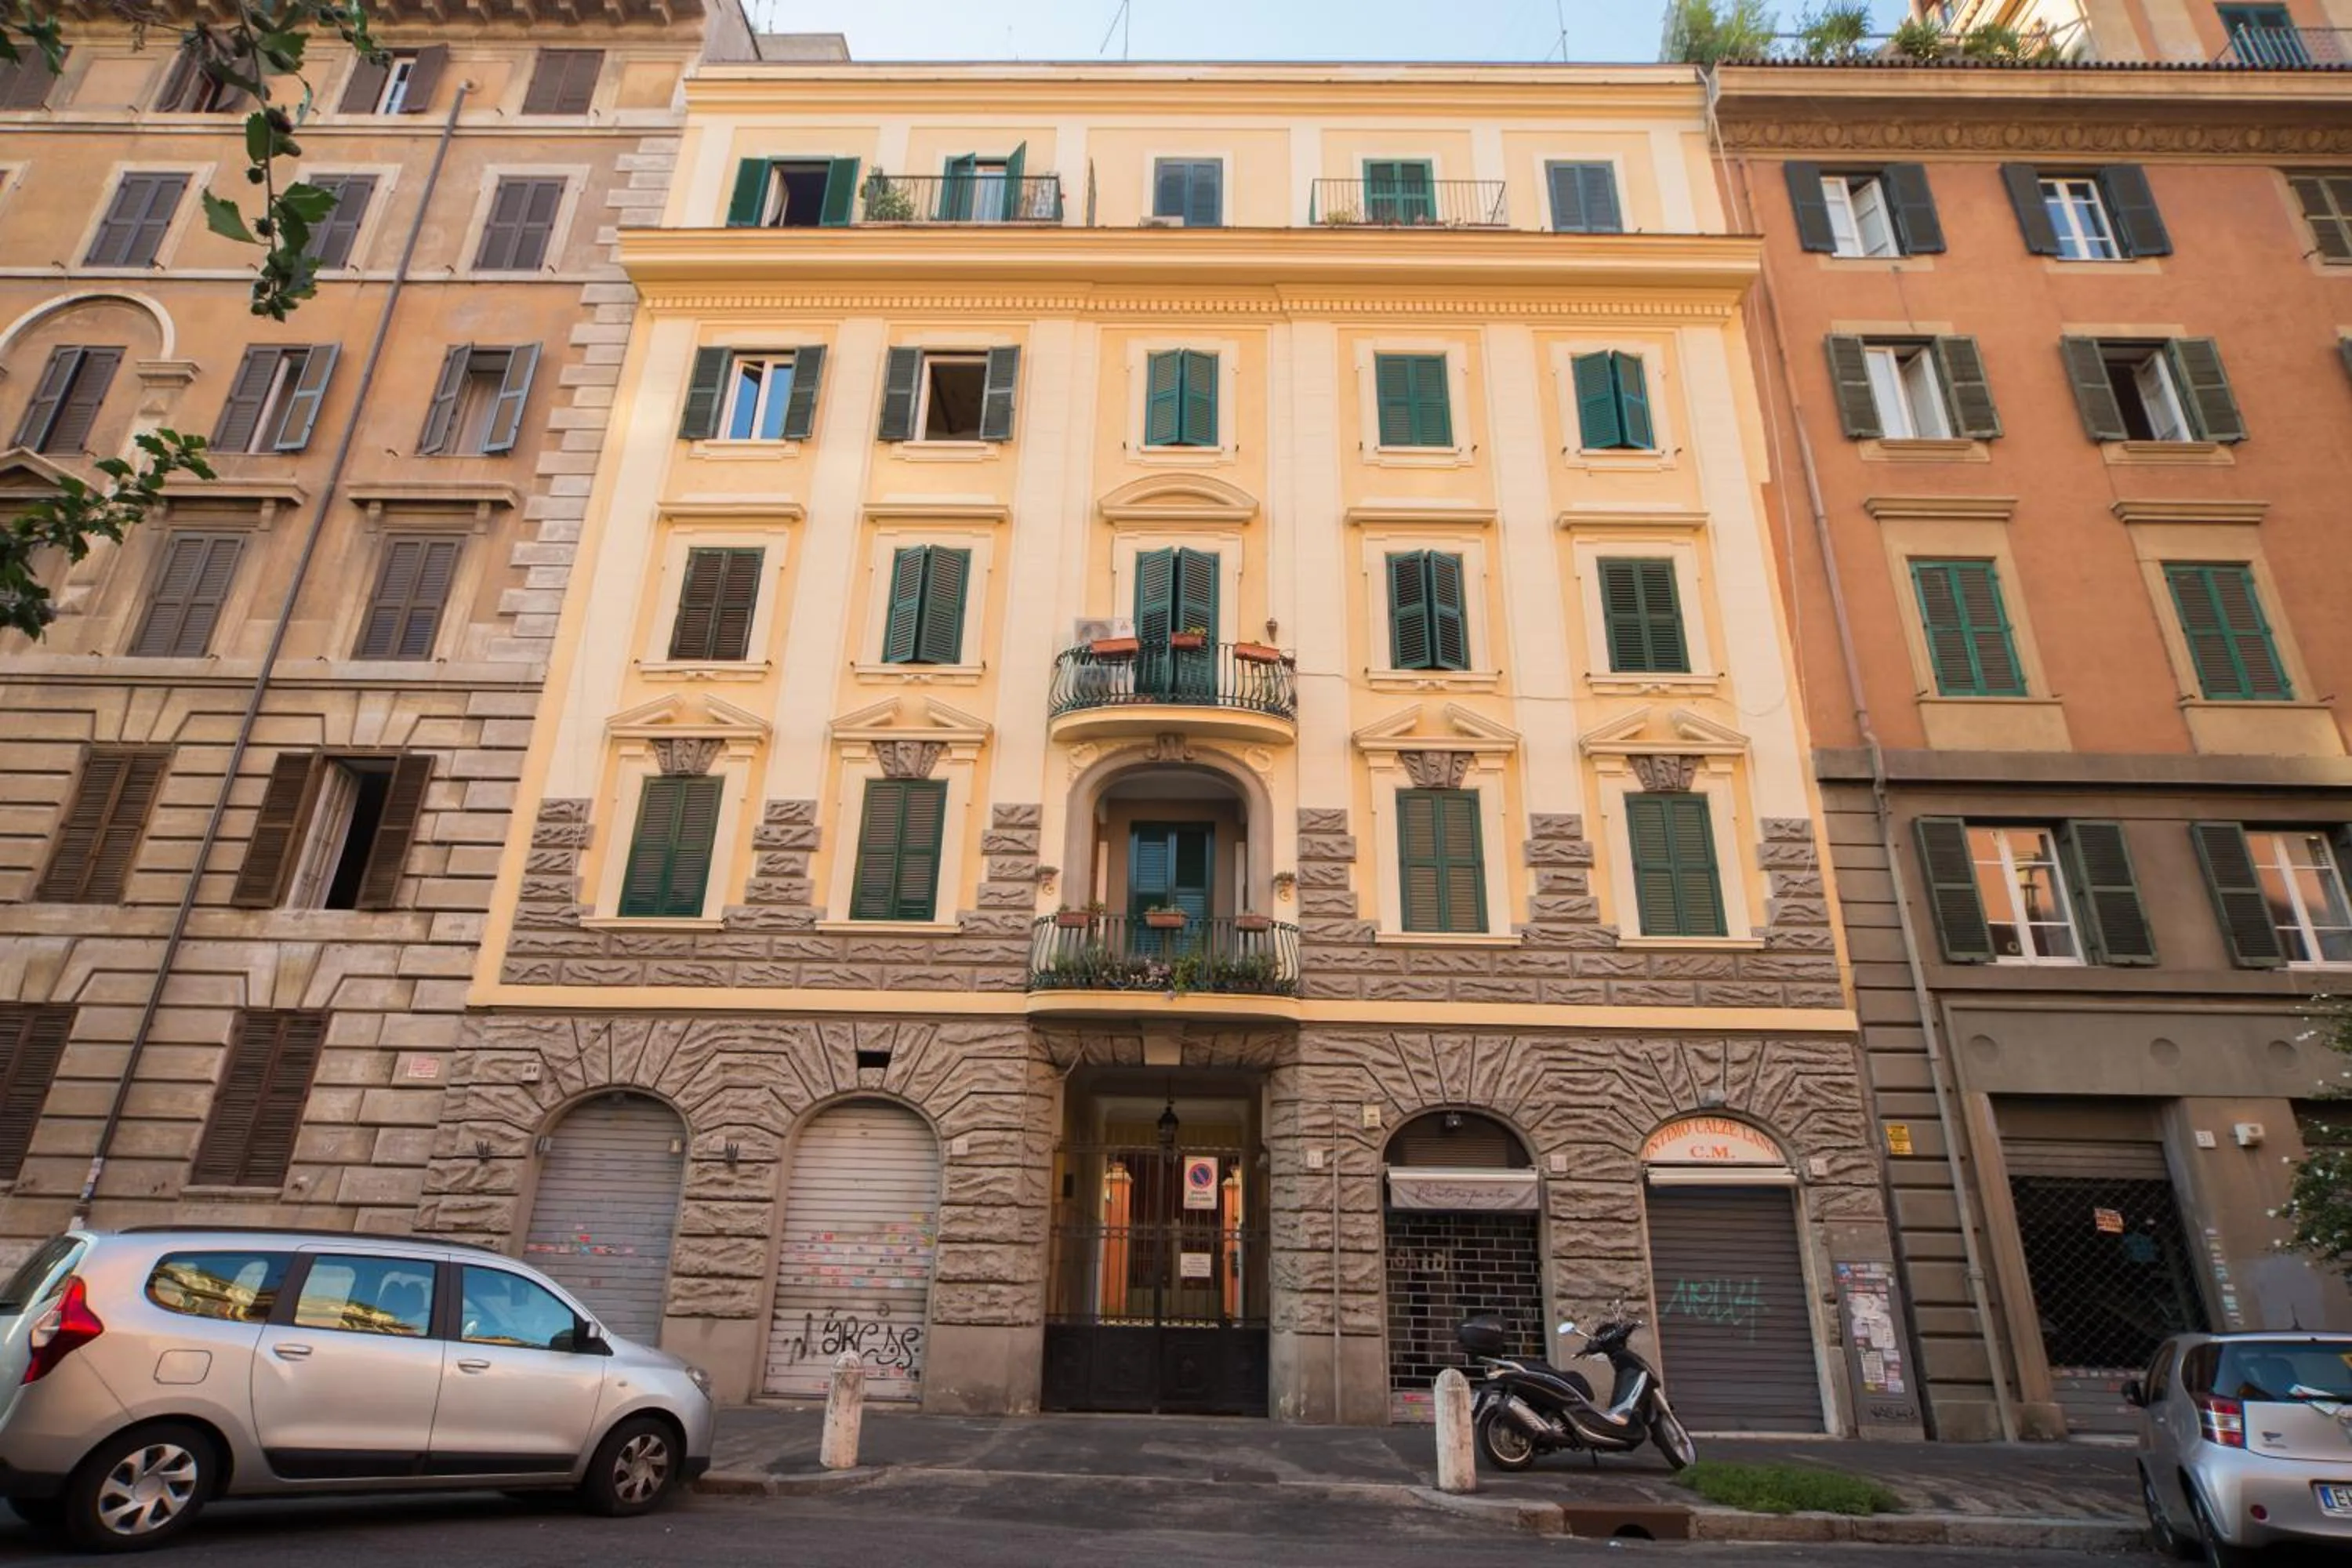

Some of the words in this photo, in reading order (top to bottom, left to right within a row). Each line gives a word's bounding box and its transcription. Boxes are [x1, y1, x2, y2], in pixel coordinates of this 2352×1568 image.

[1642, 1120, 1691, 1159] INTIMO
[1694, 1118, 1738, 1135] CALZE
[1690, 1145, 1736, 1159] C.M.
